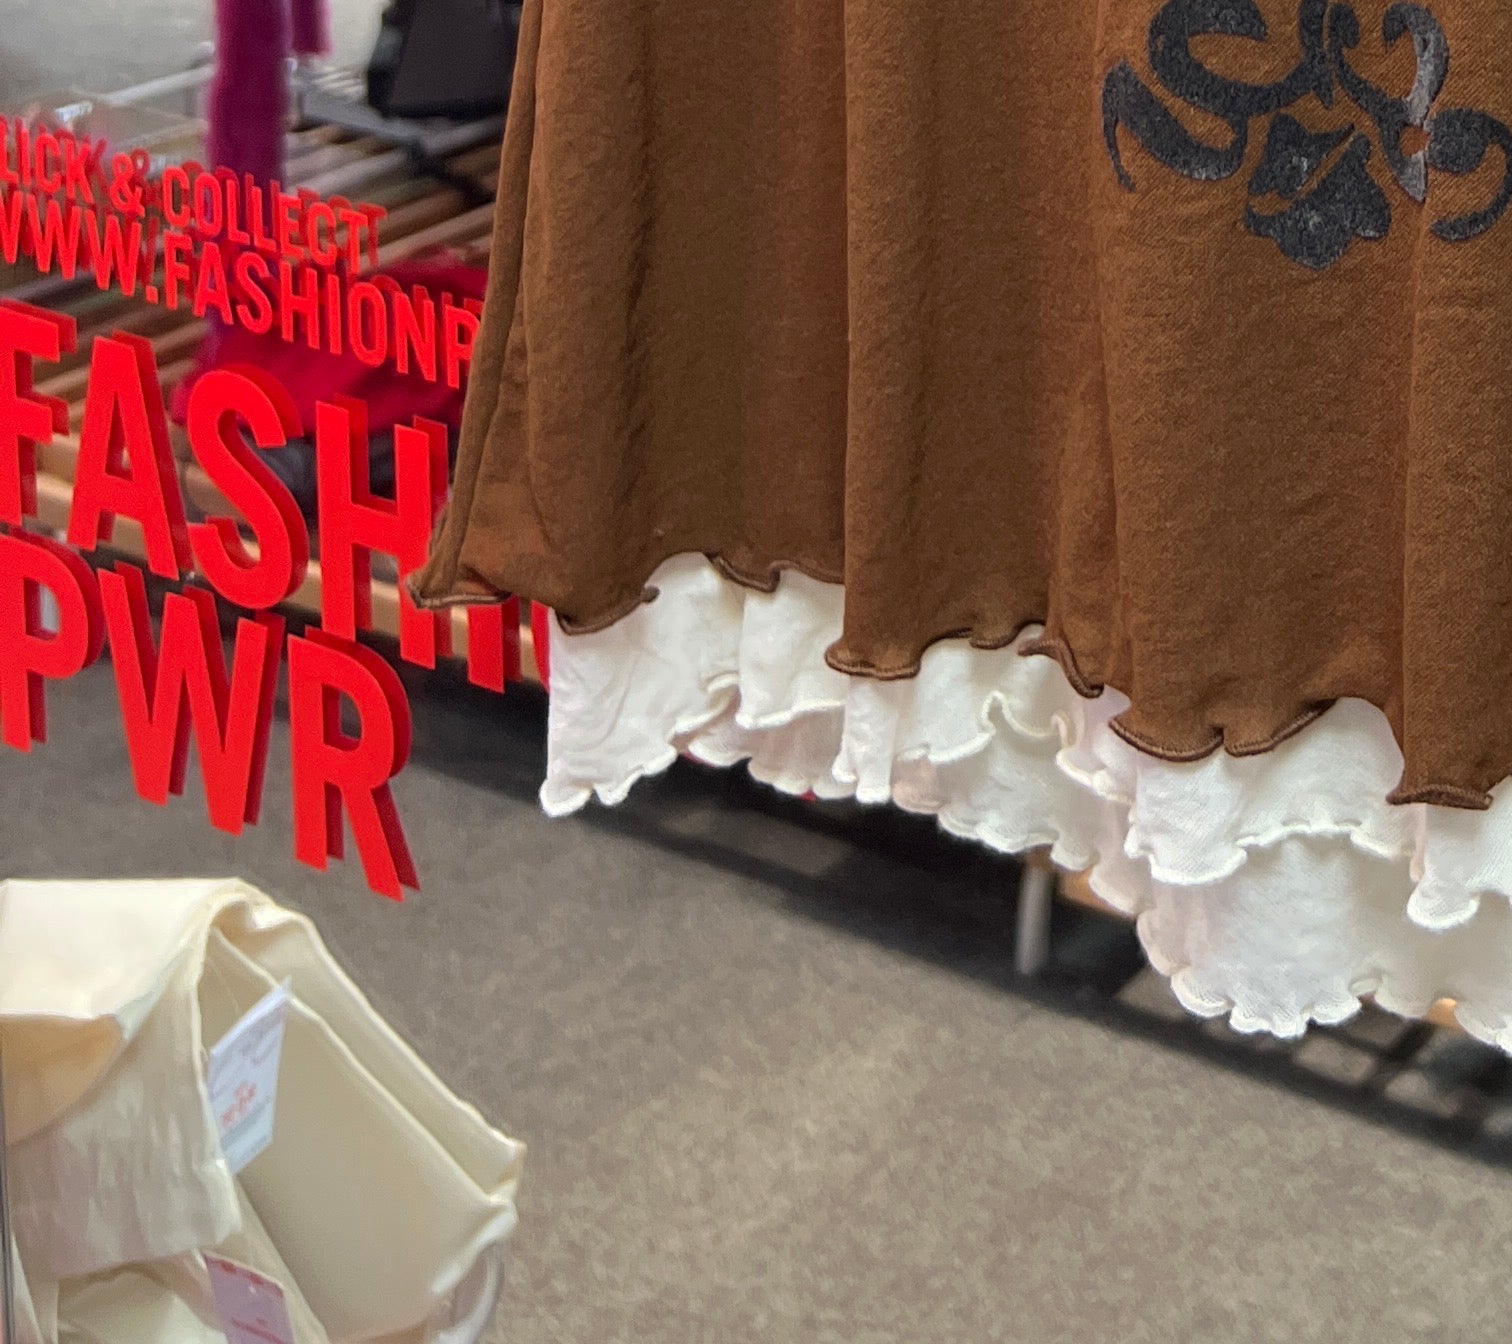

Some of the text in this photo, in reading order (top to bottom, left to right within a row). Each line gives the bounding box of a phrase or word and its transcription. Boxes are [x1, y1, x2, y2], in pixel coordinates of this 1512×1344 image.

[108, 153, 146, 217] &
[162, 165, 370, 275] COLLECT
[0, 303, 549, 694] FASH
[0, 535, 404, 902] PWR
